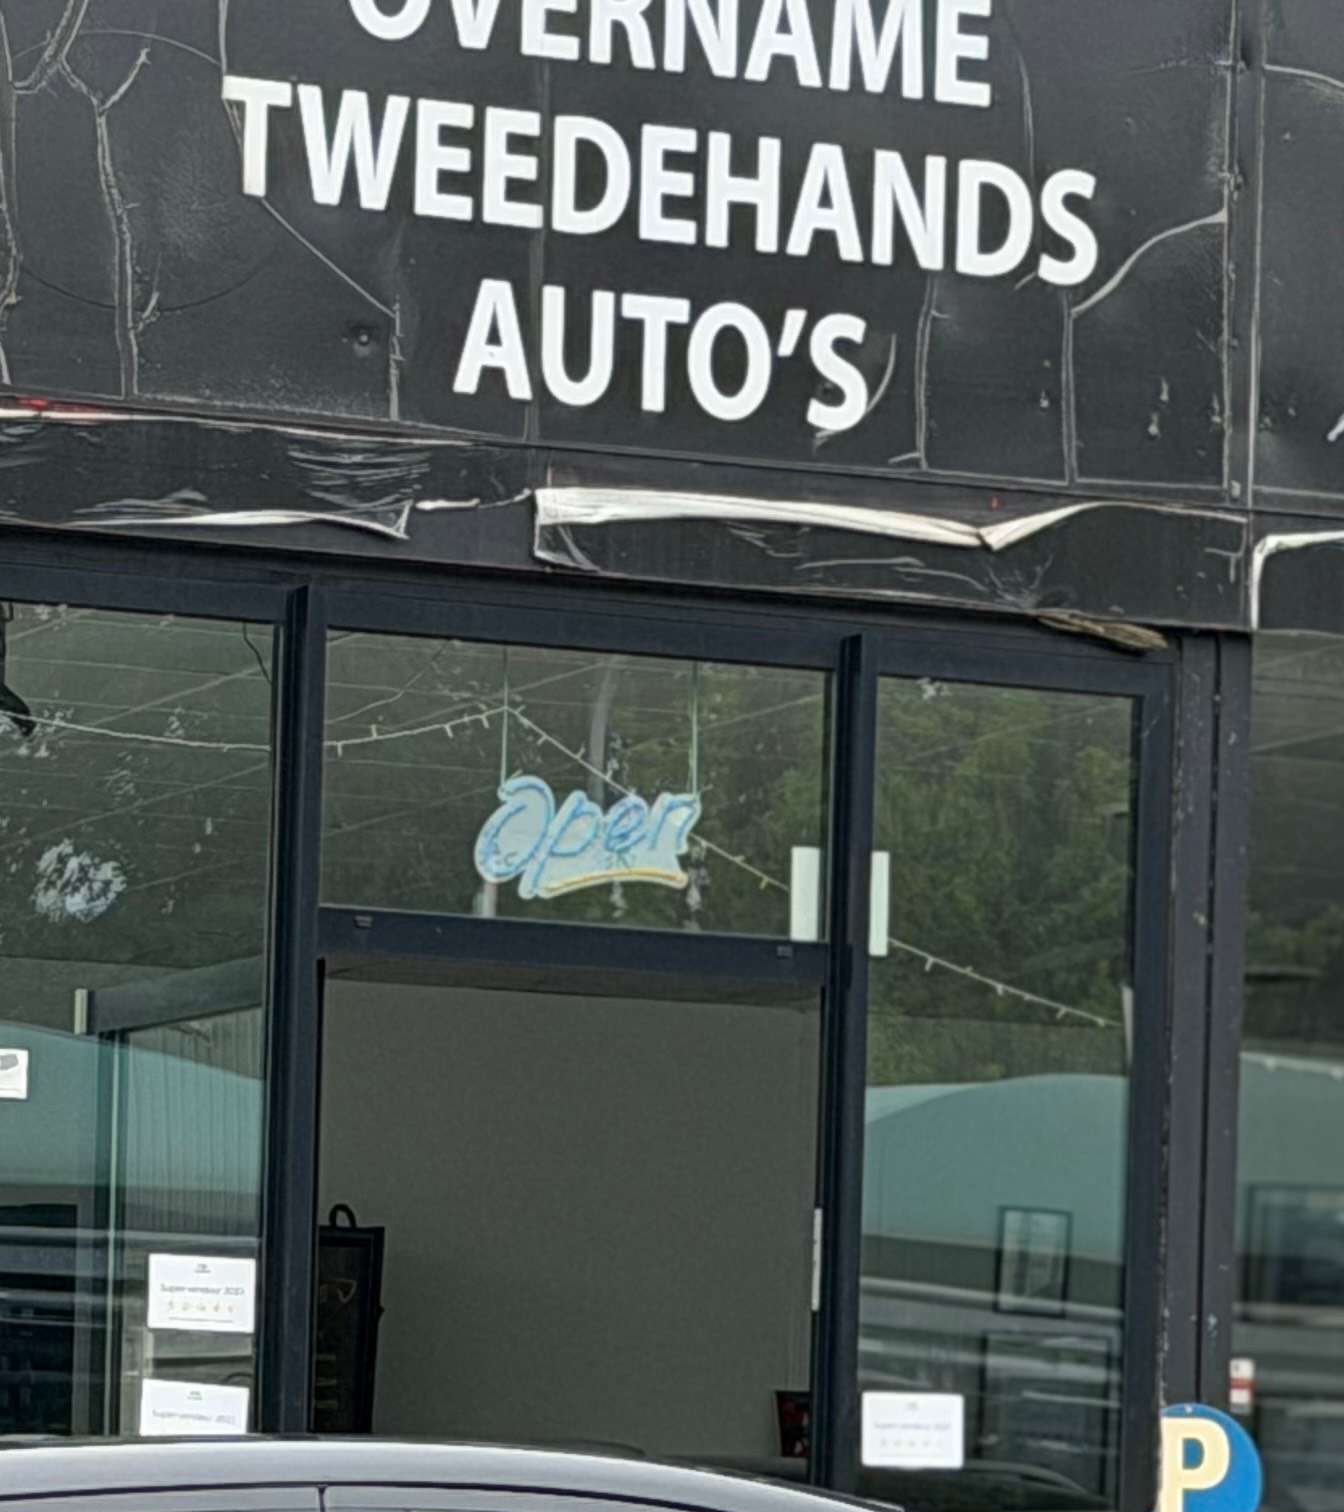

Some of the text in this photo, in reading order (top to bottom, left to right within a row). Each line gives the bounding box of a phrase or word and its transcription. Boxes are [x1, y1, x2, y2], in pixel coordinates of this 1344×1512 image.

[221, 75, 1098, 286] TWEEDEHANDS
[452, 278, 868, 431] AUTO'S
[475, 777, 701, 898] Open
